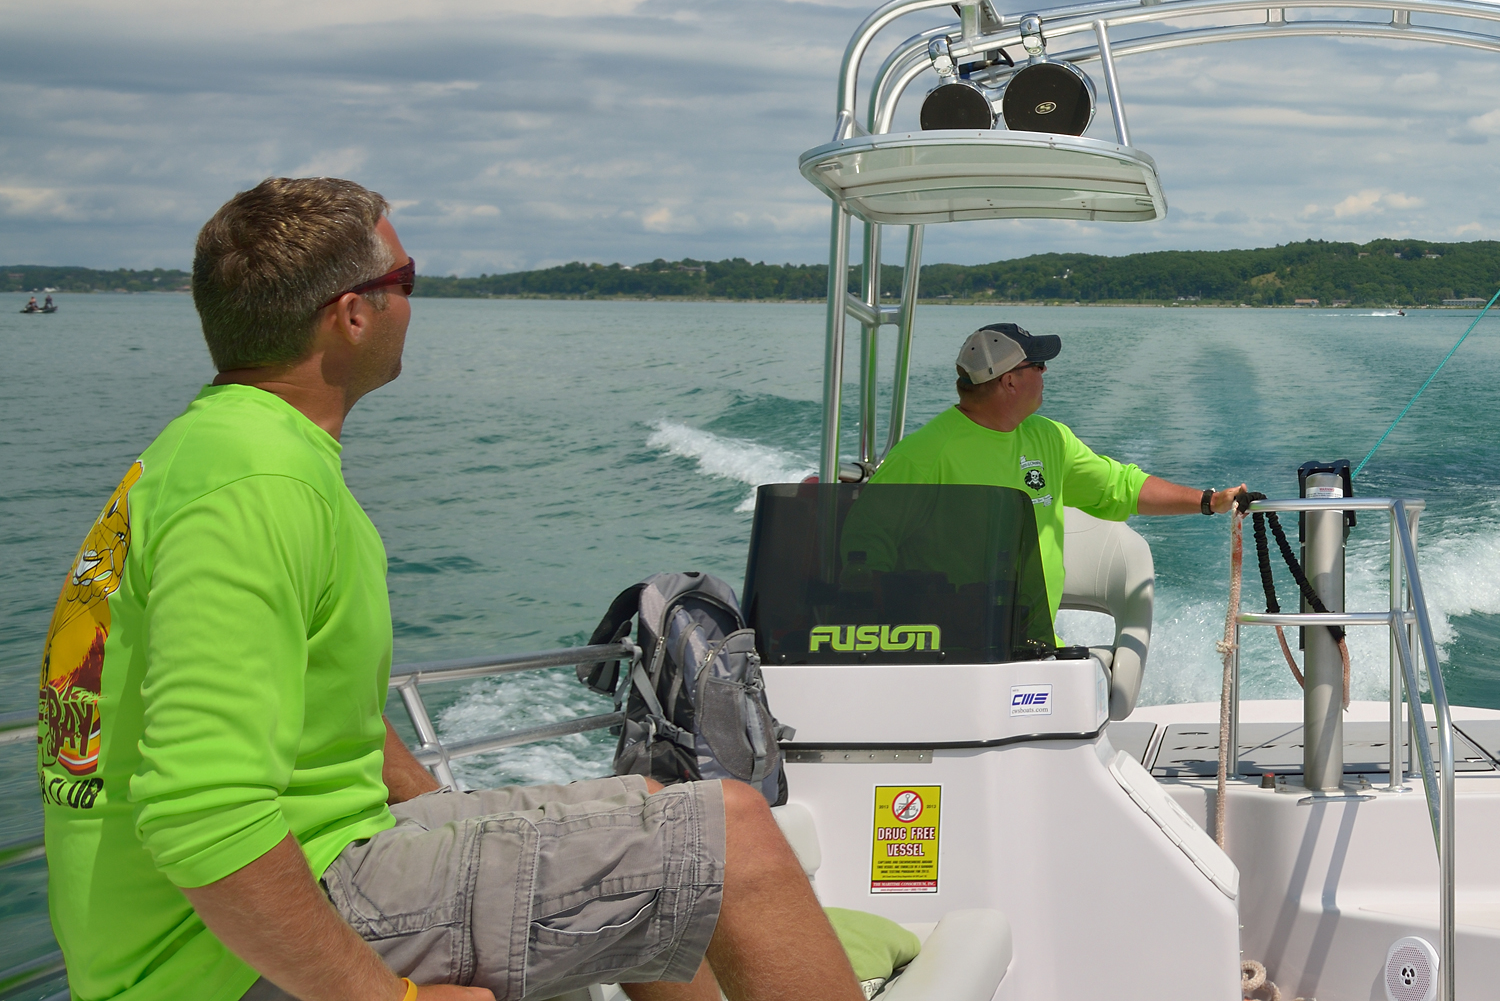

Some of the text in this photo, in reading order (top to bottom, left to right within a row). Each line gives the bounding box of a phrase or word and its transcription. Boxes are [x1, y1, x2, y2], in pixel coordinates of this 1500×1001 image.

[809, 625, 940, 651] FUSION
[47, 686, 94, 758] BAY
[49, 777, 104, 809] CLUB
[877, 827, 935, 841] DRUG FREE
[887, 843, 925, 857] VESSEL
